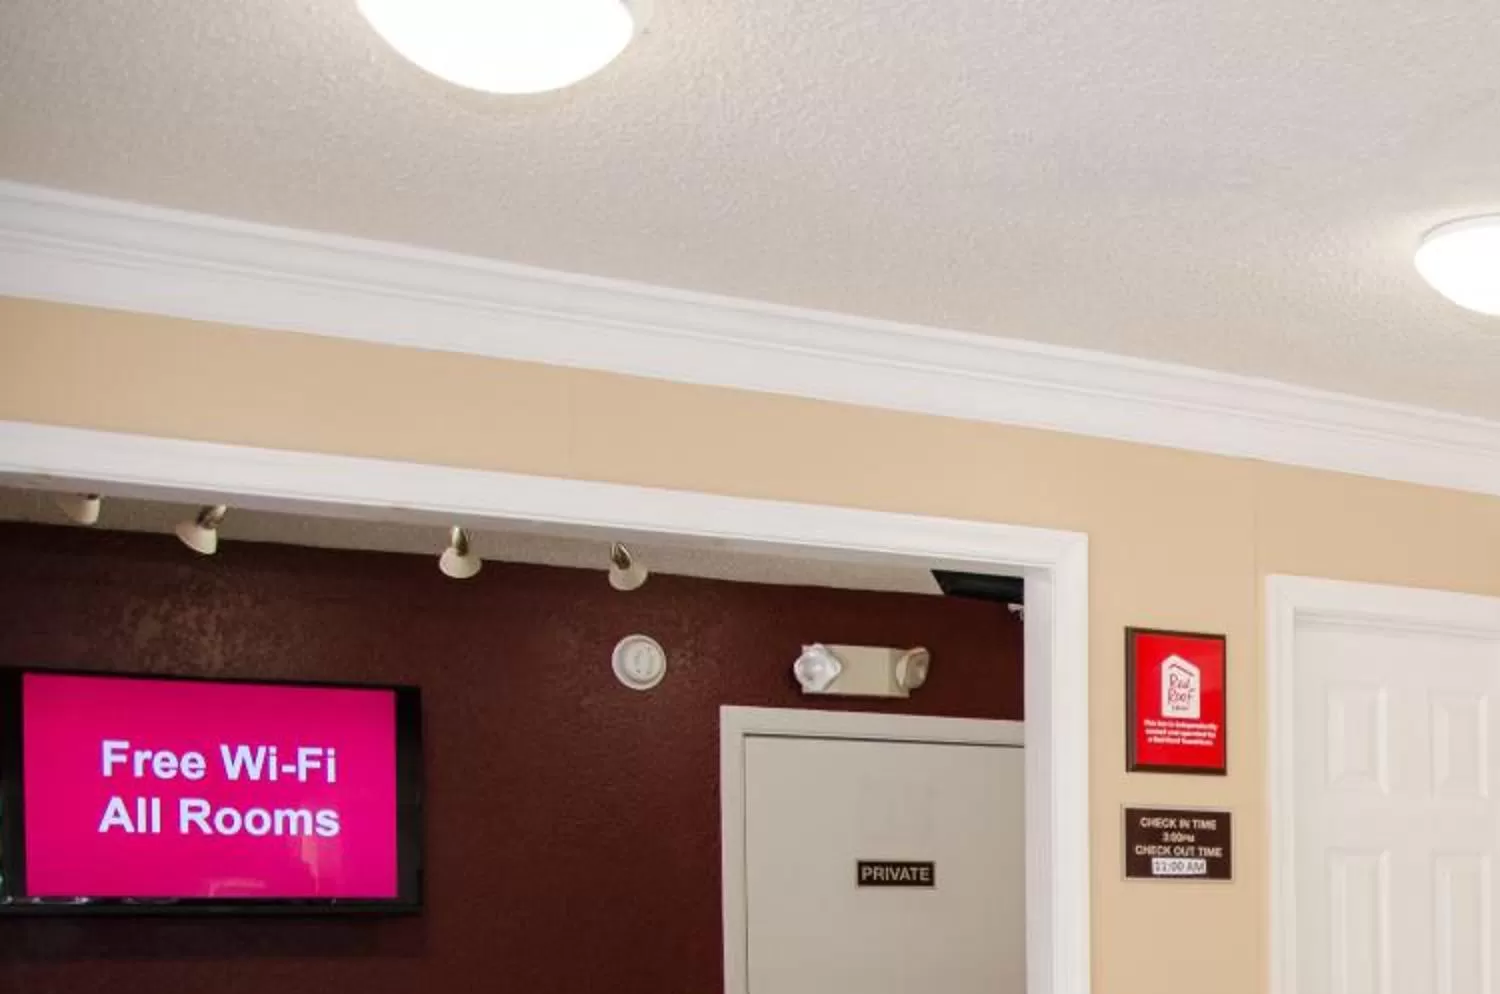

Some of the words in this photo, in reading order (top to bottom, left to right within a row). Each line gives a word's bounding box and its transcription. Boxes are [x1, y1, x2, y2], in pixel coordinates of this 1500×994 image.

[102, 739, 207, 780] Free
[219, 744, 337, 783] Wi-Fi
[98, 796, 161, 834] All
[178, 797, 341, 837] Rooms
[1140, 816, 1177, 829] CHECK
[1179, 818, 1191, 829] IN
[1192, 819, 1217, 831] TIME
[1135, 844, 1171, 856] CHECK
[1173, 845, 1195, 857] OUT
[1197, 846, 1223, 858] TIME
[861, 865, 930, 881] PRIVATE
